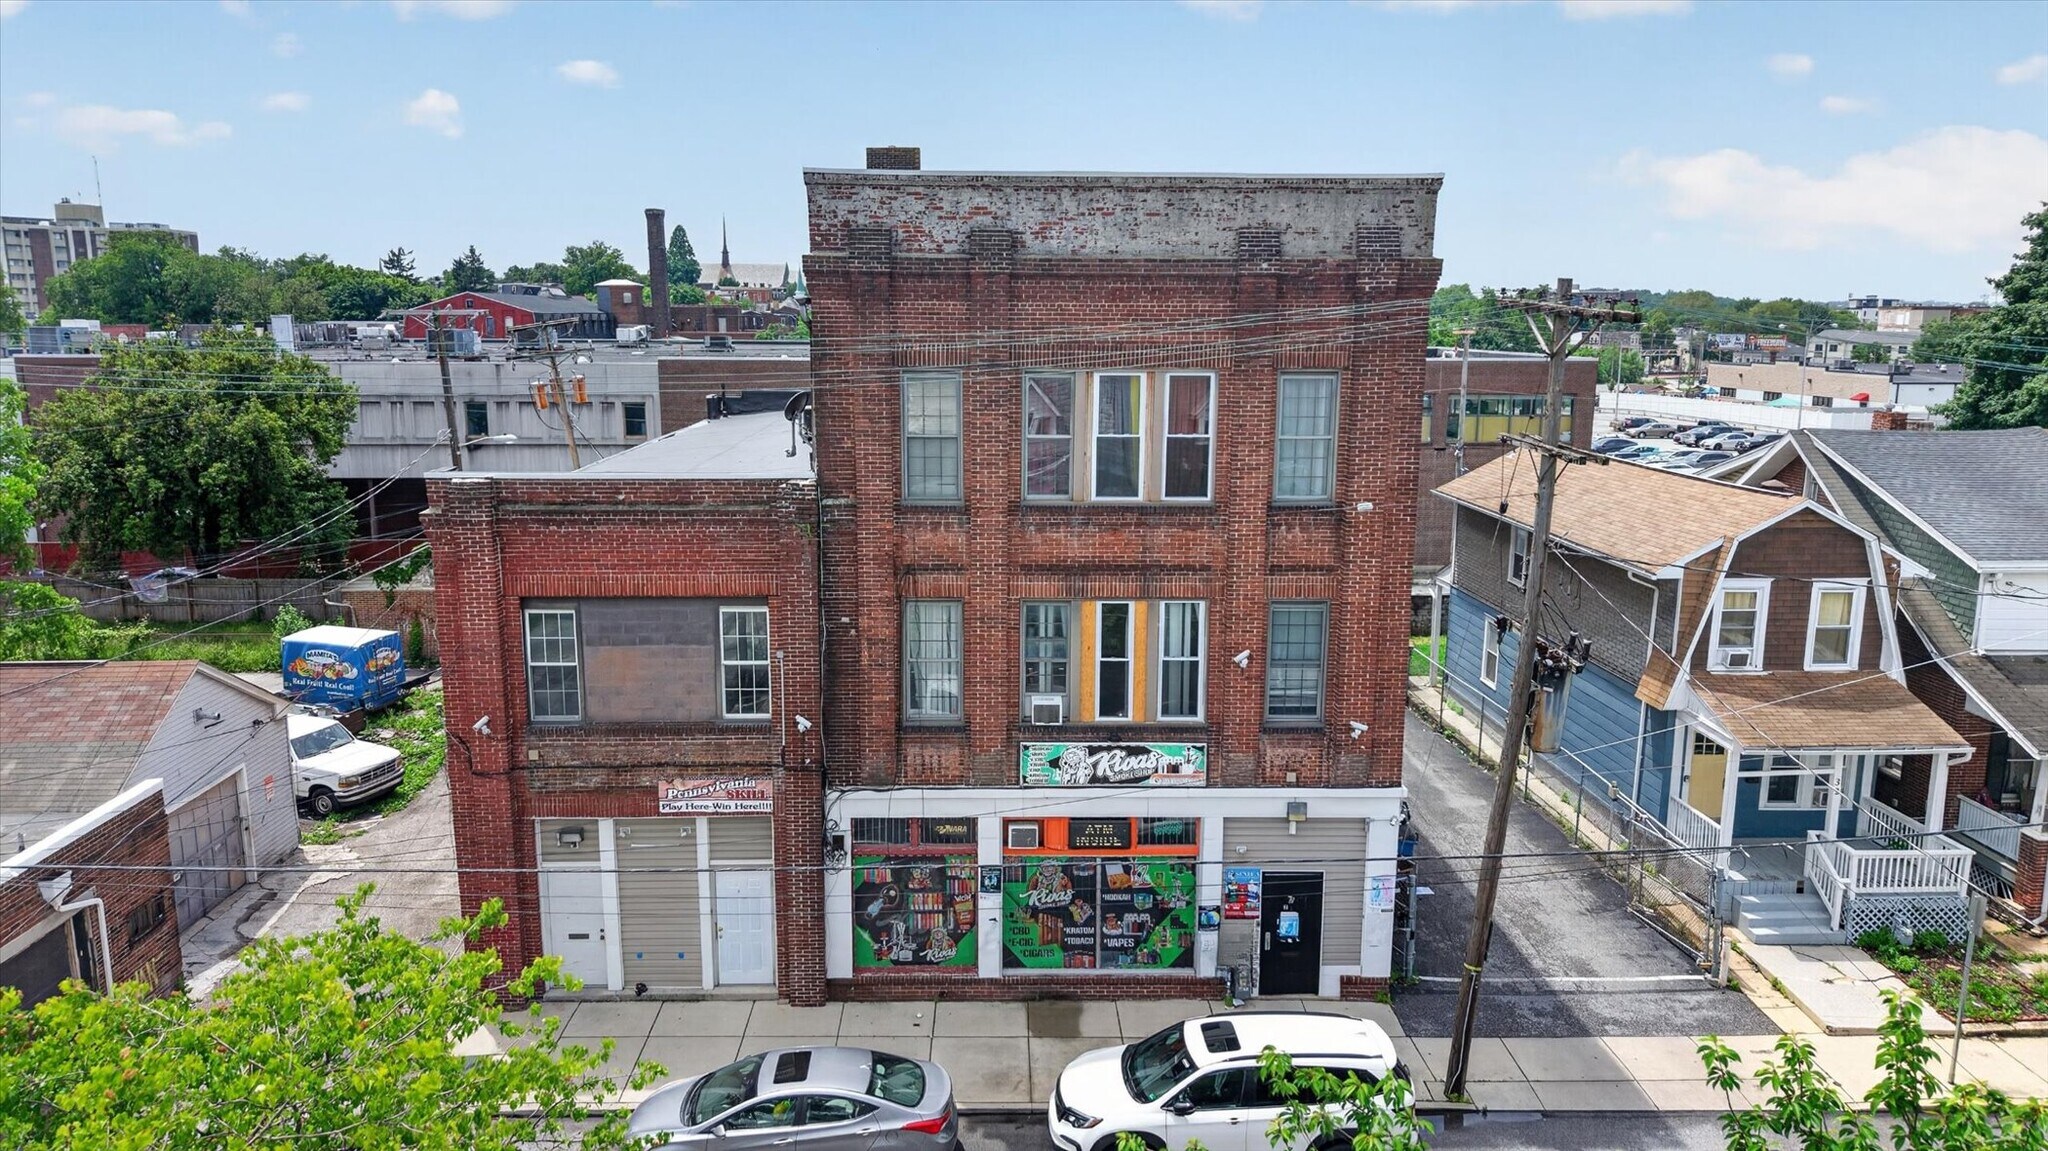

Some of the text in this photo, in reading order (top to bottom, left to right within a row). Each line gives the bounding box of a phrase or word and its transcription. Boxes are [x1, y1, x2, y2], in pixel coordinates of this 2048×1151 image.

[307, 651, 338, 661] MAMITA'S
[292, 677, 306, 685] Real
[324, 681, 338, 689] Real
[666, 777, 757, 799] Pennsylvania
[726, 789, 766, 799] SKILL
[661, 803, 683, 811] Play
[1085, 824, 1114, 834] ATM
[1076, 837, 1122, 846] INSIDE
[1019, 888, 1076, 907] Rivas
[1107, 938, 1135, 947] VAPES
